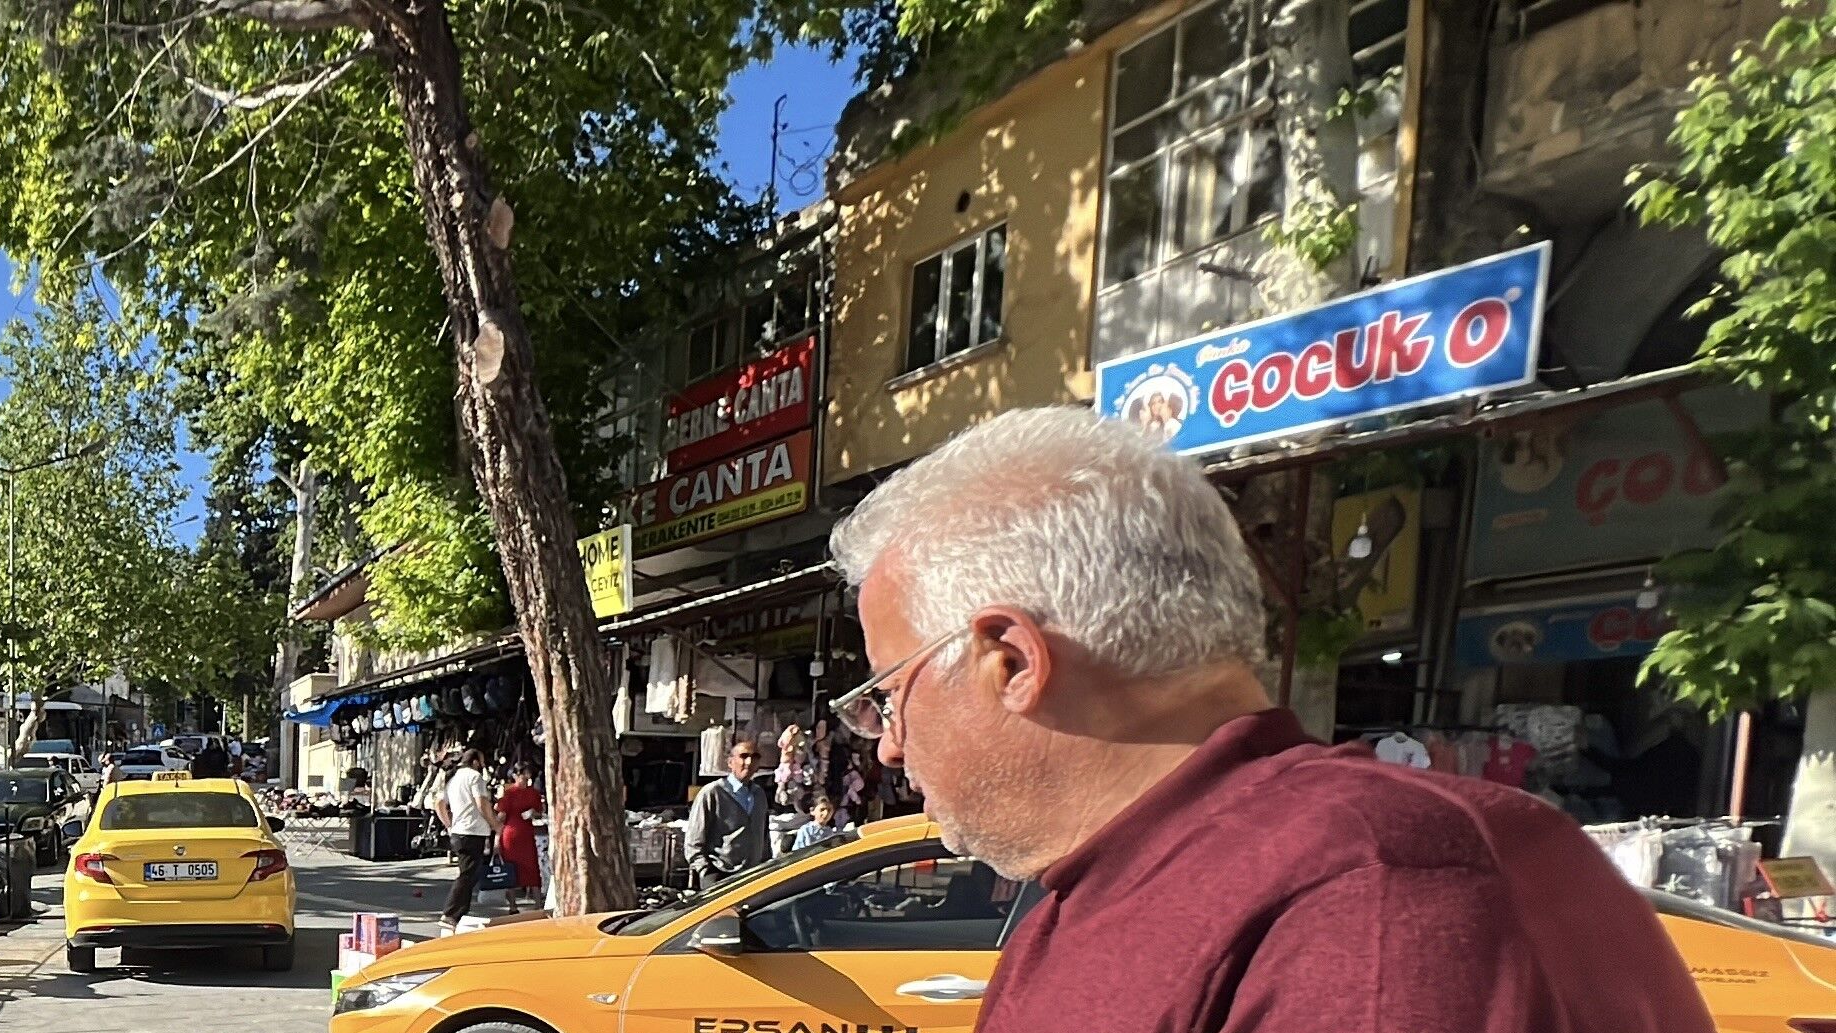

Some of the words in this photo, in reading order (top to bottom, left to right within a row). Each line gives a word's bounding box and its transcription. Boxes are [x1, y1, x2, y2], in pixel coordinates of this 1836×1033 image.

[151, 864, 165, 876] 46
[173, 864, 179, 876] T
[188, 863, 215, 876] 0505
